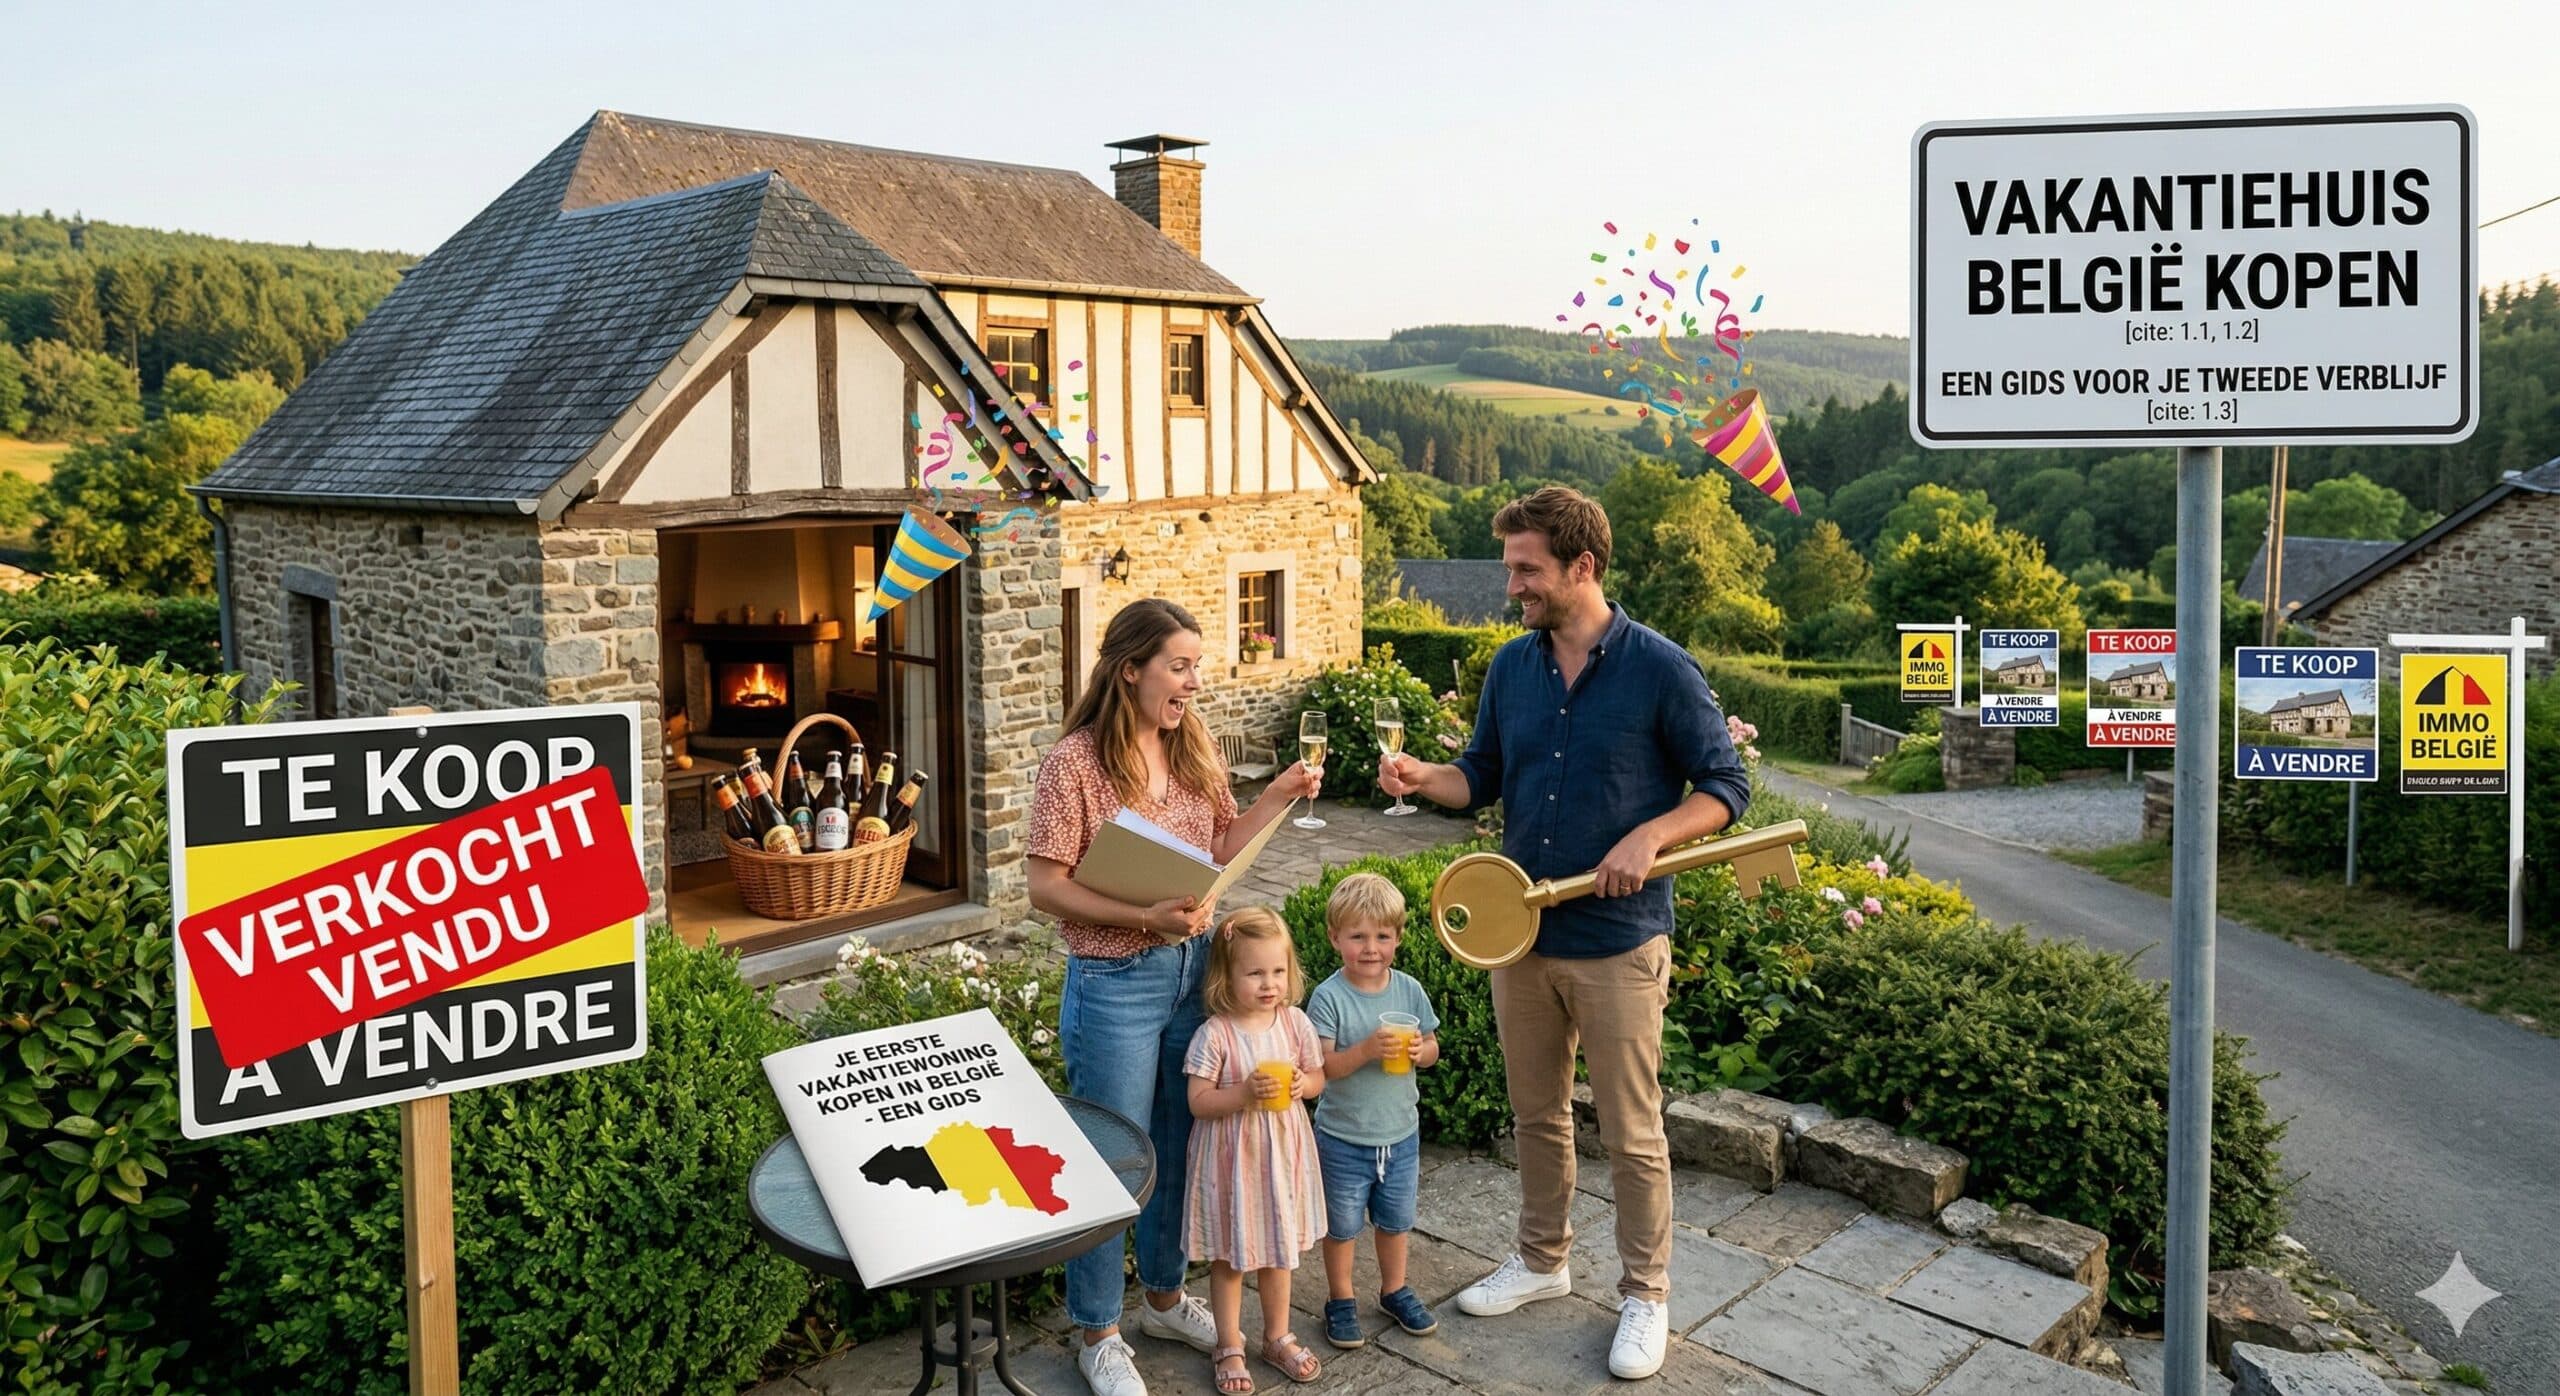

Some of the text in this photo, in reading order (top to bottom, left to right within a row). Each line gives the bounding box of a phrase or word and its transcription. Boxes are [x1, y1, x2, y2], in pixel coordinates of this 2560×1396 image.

[1954, 168, 2431, 236] VAKANTIEHUIS
[1967, 242, 2419, 315] BELGIË KOPEN
[2125, 318, 2260, 344] [cite: 1.1, 1.2]
[1941, 363, 2448, 397] EEN GIDS VOOR JE TWEEDE VERBLIJF
[2147, 398, 2239, 424] [cite: 1.3]
[1989, 634, 2049, 647] TE KOOP
[2097, 635, 2172, 650] TE KOOP
[1910, 661, 1945, 672] IMMO
[2256, 654, 2359, 675] TE KOOP
[2004, 696, 2043, 706] VENDRE
[1987, 708, 2053, 723] À VENDRE
[2107, 709, 2162, 721] À VENDRE
[2419, 713, 2489, 733] IMMO
[2094, 724, 2176, 741] À VENDRE
[2411, 735, 2497, 758] BELGIË
[2248, 749, 2366, 774] À VENDRE
[221, 736, 596, 827] TE KOOP
[203, 786, 597, 978] VERKOCHT
[307, 884, 551, 1014] VENDU
[307, 980, 615, 1087] VENDRE
[835, 1034, 945, 1069] JE EERSTE
[798, 1043, 998, 1097] VAKANTIEWONING
[817, 1059, 1004, 1116] KOPEN IN BELGIË
[877, 1100, 925, 1124] EEN
[927, 1088, 982, 1111] GIDS
